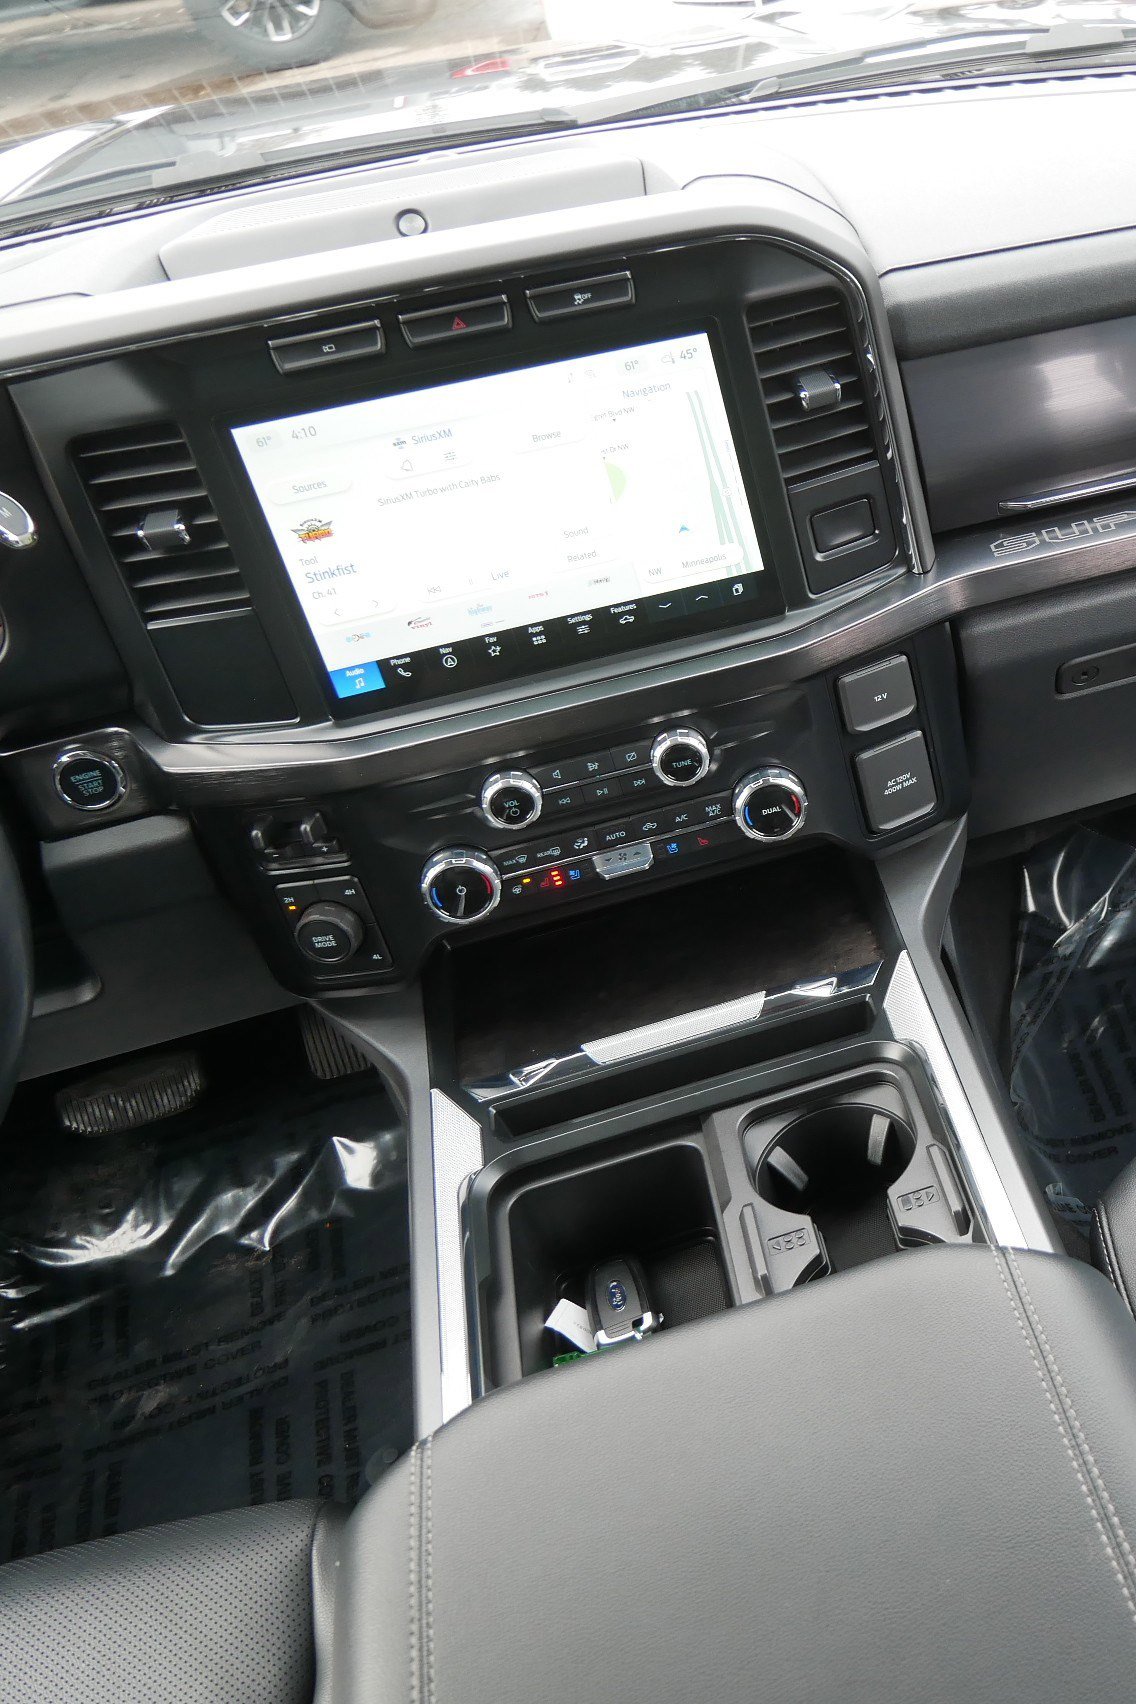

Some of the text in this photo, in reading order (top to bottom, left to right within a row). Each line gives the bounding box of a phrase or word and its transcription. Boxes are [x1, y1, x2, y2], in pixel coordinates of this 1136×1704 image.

[582, 292, 592, 300] OFF
[622, 381, 672, 399] Navigation
[290, 425, 317, 440] 4:10
[412, 428, 453, 445] SiriusXM
[532, 430, 562, 443] Browse
[292, 480, 327, 494] Sources
[377, 491, 414, 507] SiriusXM
[414, 485, 438, 499] Turbo
[439, 481, 458, 495] with
[480, 473, 501, 487] Babs
[563, 526, 589, 539] Sound
[299, 555, 318, 567] Tool
[567, 550, 598, 563] Related
[648, 552, 727, 577] NW Minneapolis
[305, 563, 357, 584] Stinkfist
[491, 569, 510, 581] Live
[610, 603, 636, 614] Features
[567, 613, 592, 624] Settings
[528, 625, 544, 635] Apps
[485, 635, 497, 643] Fav
[439, 646, 452, 655] Nav
[390, 655, 411, 666] Phone
[346, 667, 364, 677] Audio
[672, 759, 693, 768] TUNE
[70, 770, 102, 782] ENGINE
[903, 776, 918, 787] MAX
[79, 780, 103, 791] START
[887, 779, 896, 787] AC
[83, 786, 104, 797] STOP
[503, 800, 520, 808] VOL
[705, 803, 721, 812] MAX
[762, 806, 782, 816] DUAL
[675, 814, 689, 823] A/C
[606, 831, 626, 841] AUTO
[503, 858, 516, 867] MAX
[344, 888, 356, 896] 4H
[312, 935, 335, 943] DRIVE
[315, 941, 337, 949] MODE
